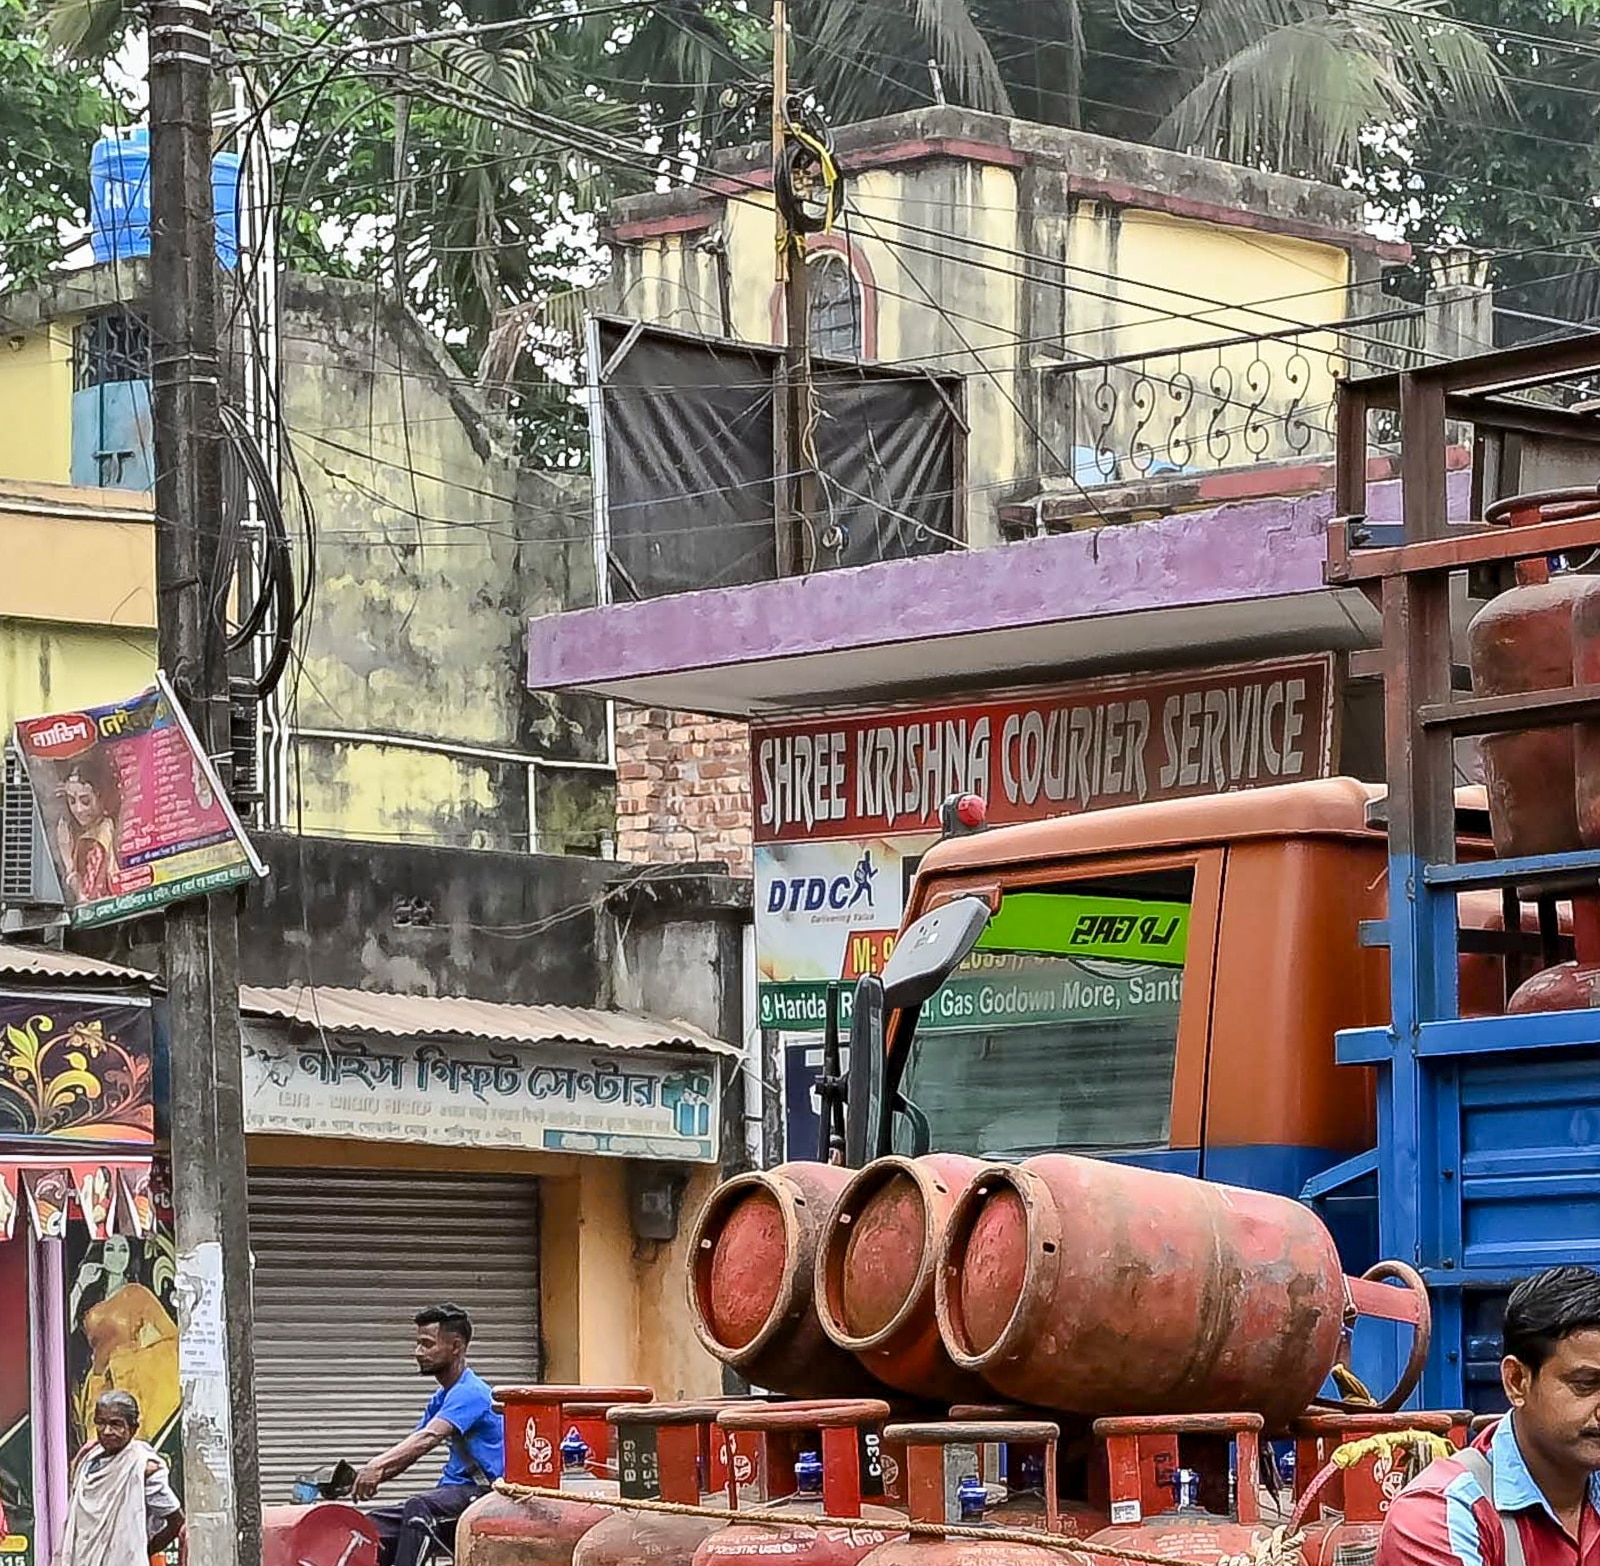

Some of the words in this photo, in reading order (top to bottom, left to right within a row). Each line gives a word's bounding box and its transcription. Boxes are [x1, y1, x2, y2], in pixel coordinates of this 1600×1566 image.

[759, 731, 846, 836] SHREE
[856, 715, 990, 828] KRISHNA
[1001, 699, 1150, 810] COURIER
[1160, 678, 1306, 792] SERVICE
[767, 875, 851, 913] DTDC
[853, 936, 877, 974] M:
[774, 993, 826, 1020] Harida
[940, 988, 974, 1017] Gas
[979, 984, 1055, 1015] Godown
[1062, 980, 1121, 1011] More,
[864, 1433, 882, 1477] C-30
